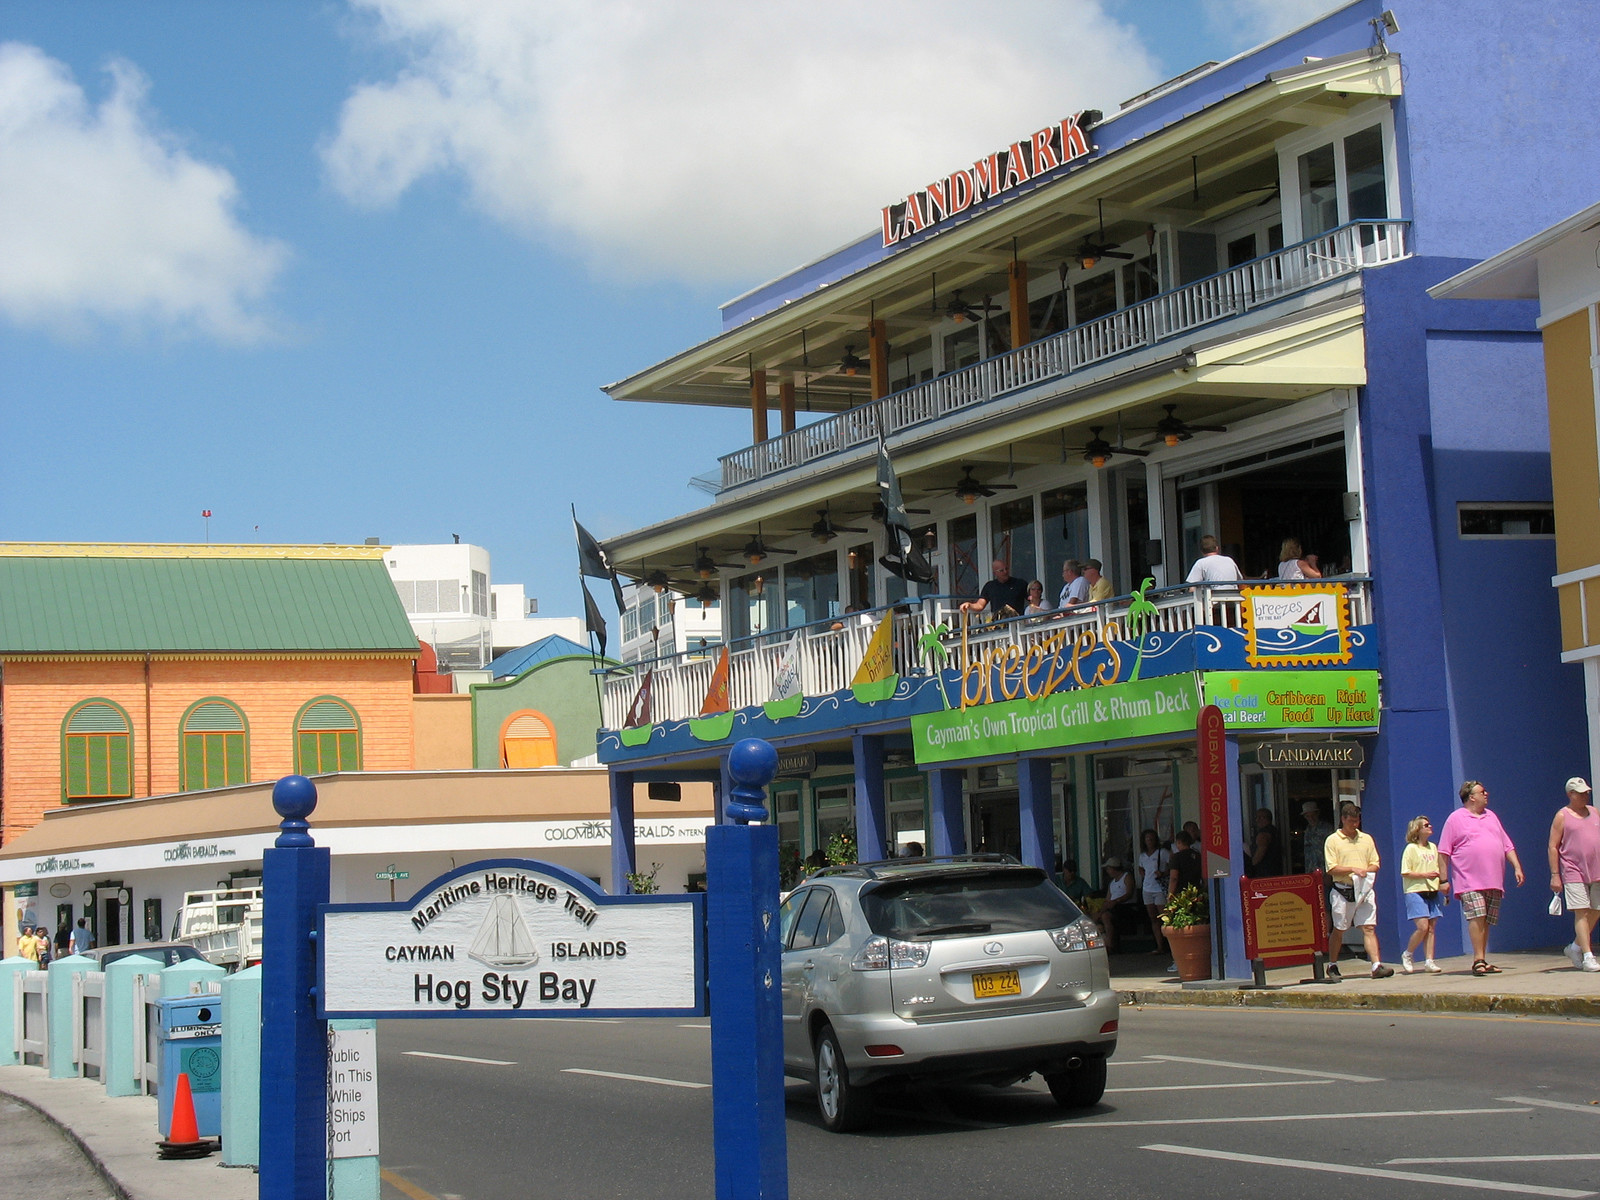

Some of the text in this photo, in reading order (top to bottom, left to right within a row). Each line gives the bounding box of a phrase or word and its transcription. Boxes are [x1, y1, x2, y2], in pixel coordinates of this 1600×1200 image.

[881, 110, 1090, 248] LANDMARK
[1253, 597, 1302, 617] breezes
[960, 607, 1121, 713] breezes
[1214, 694, 1258, 708] Ice Cold
[1267, 690, 1326, 705] Caribbean
[1337, 689, 1366, 706] Right
[927, 688, 1190, 749] Cayman's Own Tropical Grill & Rhum Deck
[1223, 710, 1266, 723] cal Beer!
[1282, 708, 1314, 723] Food!
[1327, 707, 1375, 724] Up Here!
[777, 755, 809, 770] ANDMARK
[1269, 748, 1353, 762] LANDMARK
[1207, 715, 1222, 847] CUBAN CIGARS
[634, 825, 675, 838] ERALDS
[411, 873, 597, 931] Maritime Heritage Trail
[385, 941, 627, 961] CAYMAN ISLANDS
[413, 971, 596, 1009] Hog Sty Bay
[975, 973, 1019, 991] 103 224
[330, 1049, 360, 1063] ublic
[335, 1069, 372, 1083] In This
[333, 1089, 362, 1103] While
[334, 1109, 366, 1125] Ships
